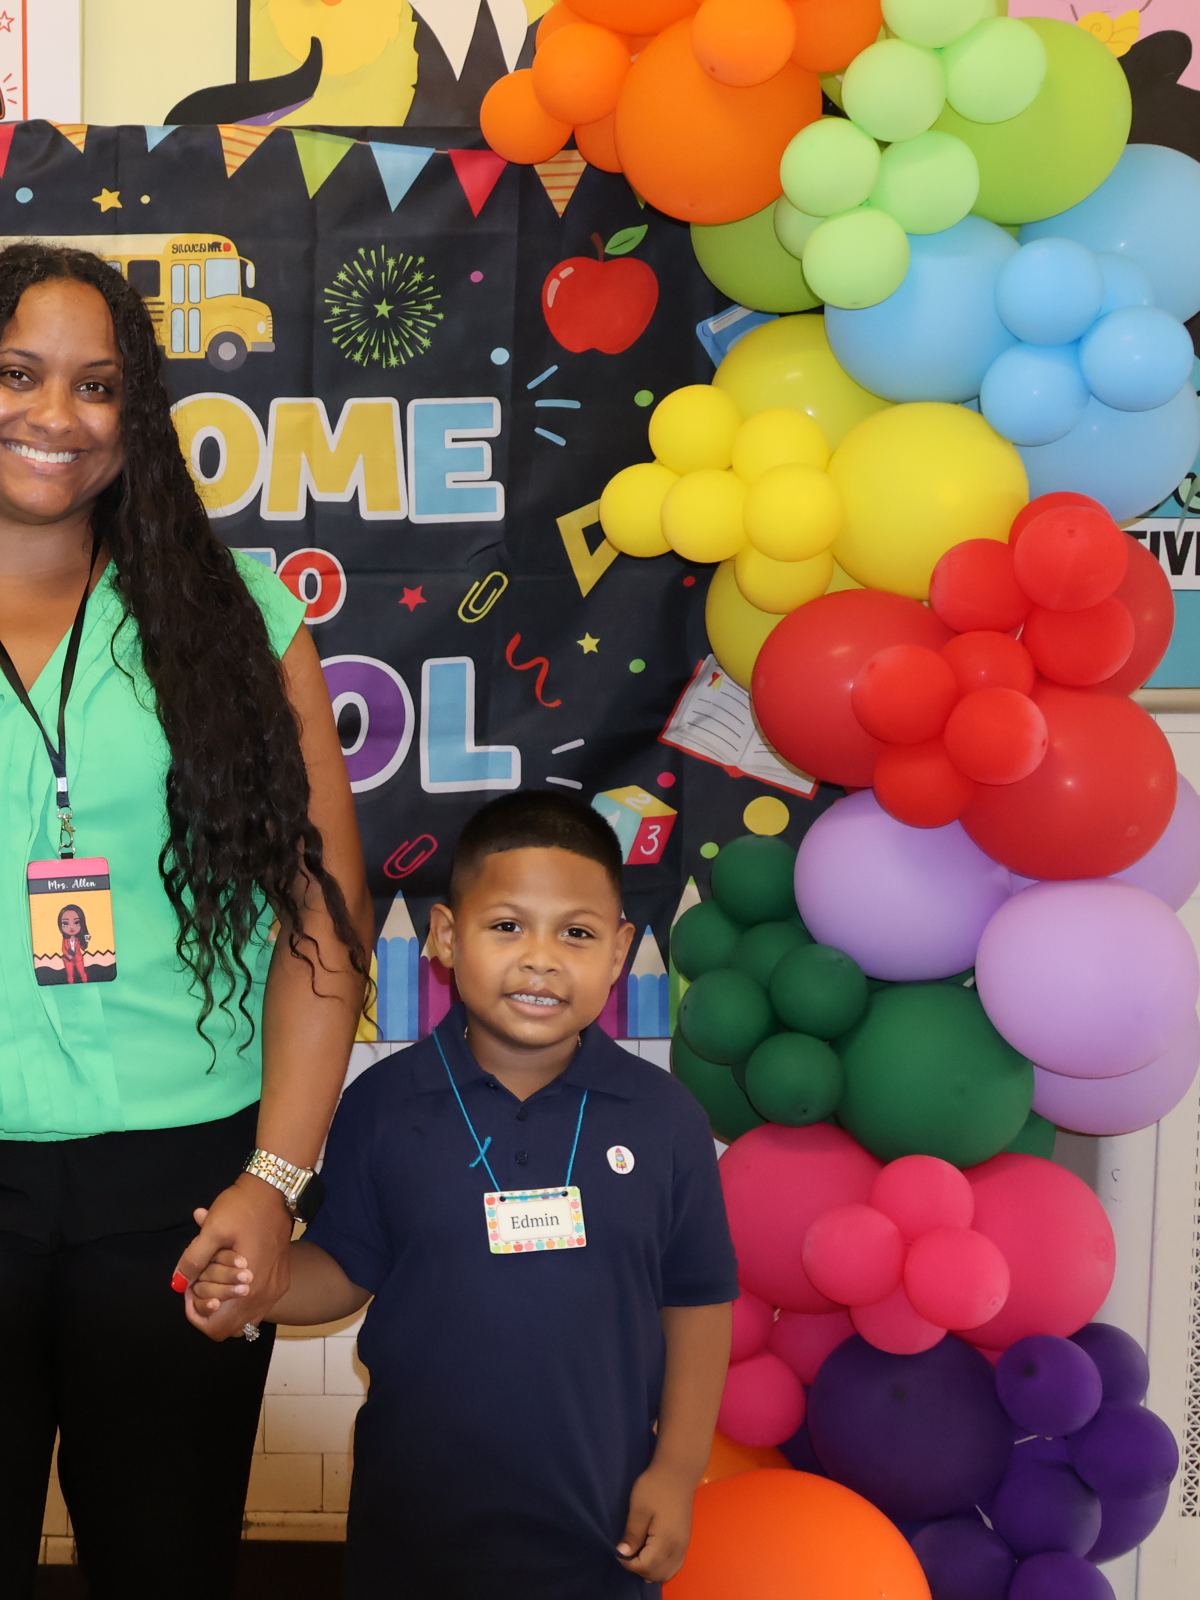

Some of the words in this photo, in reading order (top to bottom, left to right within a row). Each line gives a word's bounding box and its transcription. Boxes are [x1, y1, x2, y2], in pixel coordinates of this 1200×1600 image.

[640, 824, 661, 856] 3
[47, 880, 69, 890] Mrs.
[71, 878, 97, 889] Allen
[510, 1213, 560, 1230] Edmin
